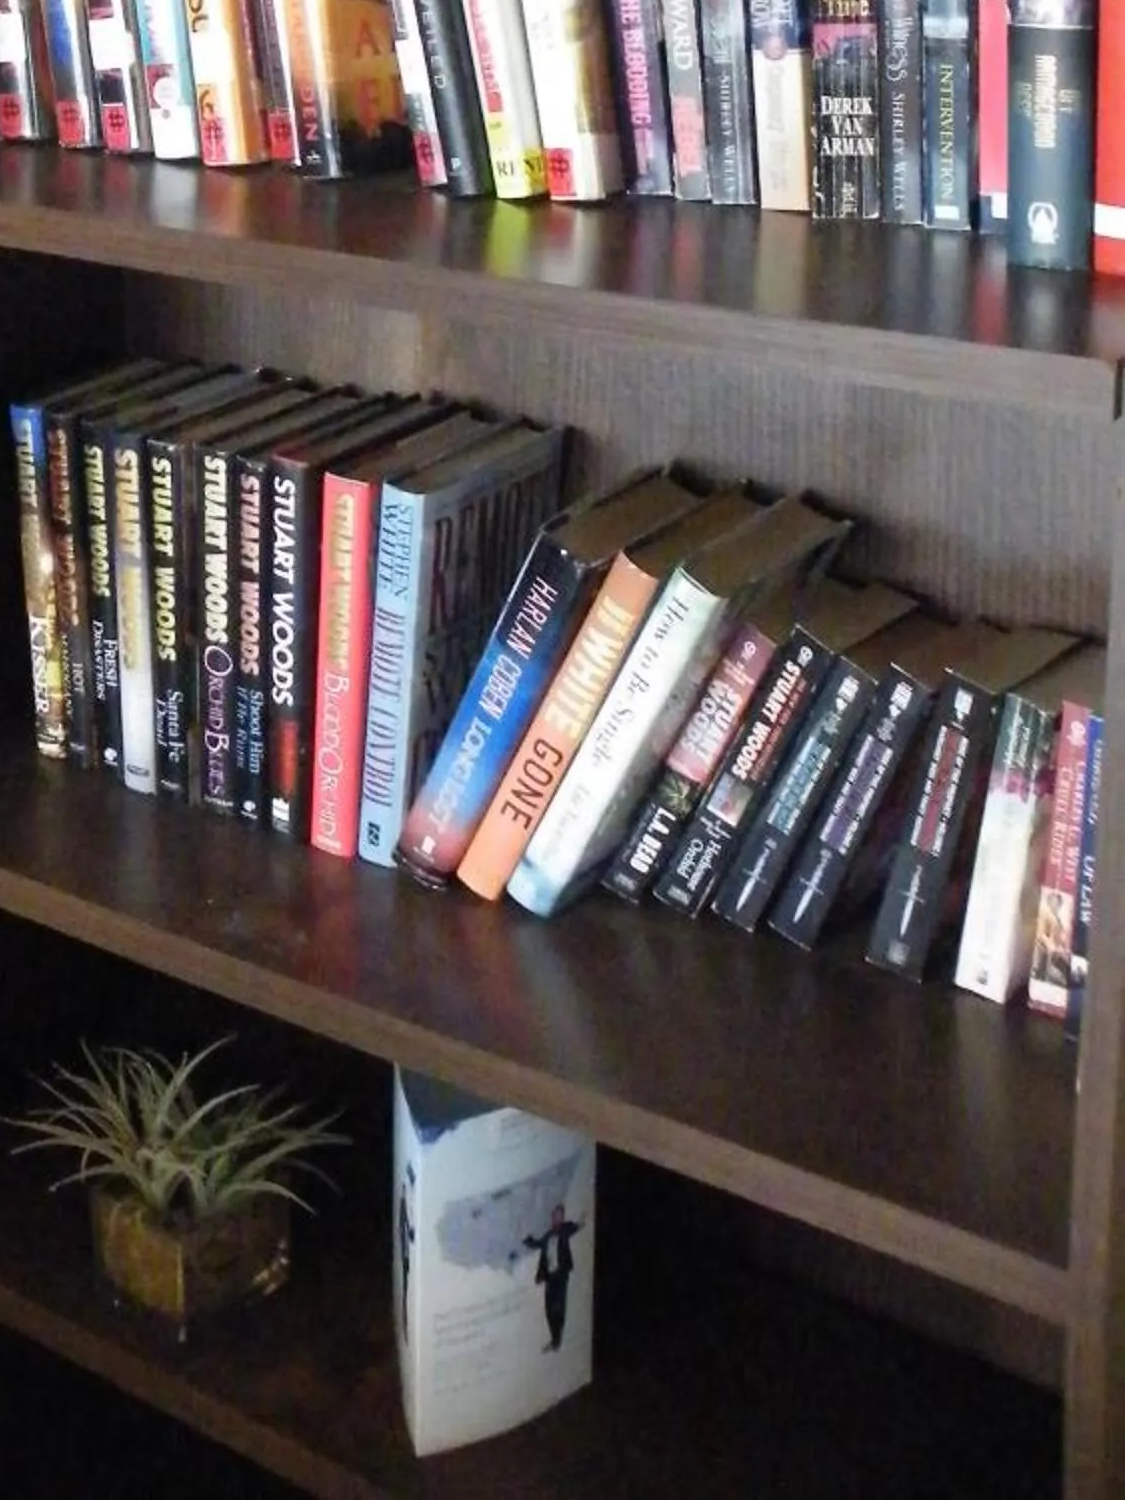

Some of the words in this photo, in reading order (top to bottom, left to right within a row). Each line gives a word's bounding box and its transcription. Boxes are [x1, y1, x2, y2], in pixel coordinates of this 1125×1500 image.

[622, 30, 652, 125] BLOODING
[821, 96, 873, 116] DEREK
[821, 137, 875, 157] ARMAN
[832, 117, 865, 135] VAN
[891, 92, 905, 155] SHIRLEY
[939, 63, 954, 199] INTERVENTION
[892, 160, 907, 211] WELLS
[84, 445, 108, 520] STUART
[114, 448, 141, 558] STUART
[152, 456, 174, 557] STUART
[203, 455, 228, 551] STUART
[90, 523, 110, 597] WOODS
[239, 473, 260, 574] STUART
[272, 476, 295, 586] STUART
[330, 493, 355, 582] STUART
[379, 502, 399, 592] WHITE
[394, 503, 415, 602] STEPHEN
[155, 566, 177, 662] WOODS
[204, 554, 229, 645] WOODS
[240, 581, 260, 676] WOODS
[327, 583, 350, 671] WOODS
[506, 575, 558, 659] HARLAN
[650, 595, 689, 642] How
[28, 615, 52, 715] KISSER
[72, 662, 84, 694] HOT
[103, 639, 118, 687] FRESH
[272, 590, 295, 707] WOODS
[371, 607, 406, 704] REMOTE
[543, 628, 625, 743] WHITE
[625, 670, 654, 699] Be
[641, 649, 663, 669] to
[166, 688, 184, 737] Santa
[203, 645, 232, 730] ORCHID
[248, 689, 264, 738] Shoot
[322, 671, 350, 749] BLOOD
[479, 654, 522, 720] COBEN
[680, 680, 723, 755] WOODS
[761, 660, 798, 723] STUART
[167, 741, 185, 763] Fe
[249, 741, 262, 774] Him
[363, 706, 400, 808] CONTROL
[587, 701, 635, 769] Single
[695, 688, 739, 763] STUART
[730, 721, 769, 781] WOODS
[318, 748, 344, 838] ORCHID
[501, 736, 565, 831] GONE
[648, 808, 676, 834] L.A.
[630, 835, 666, 874] DEAD
[1064, 845, 1080, 883] WEST
